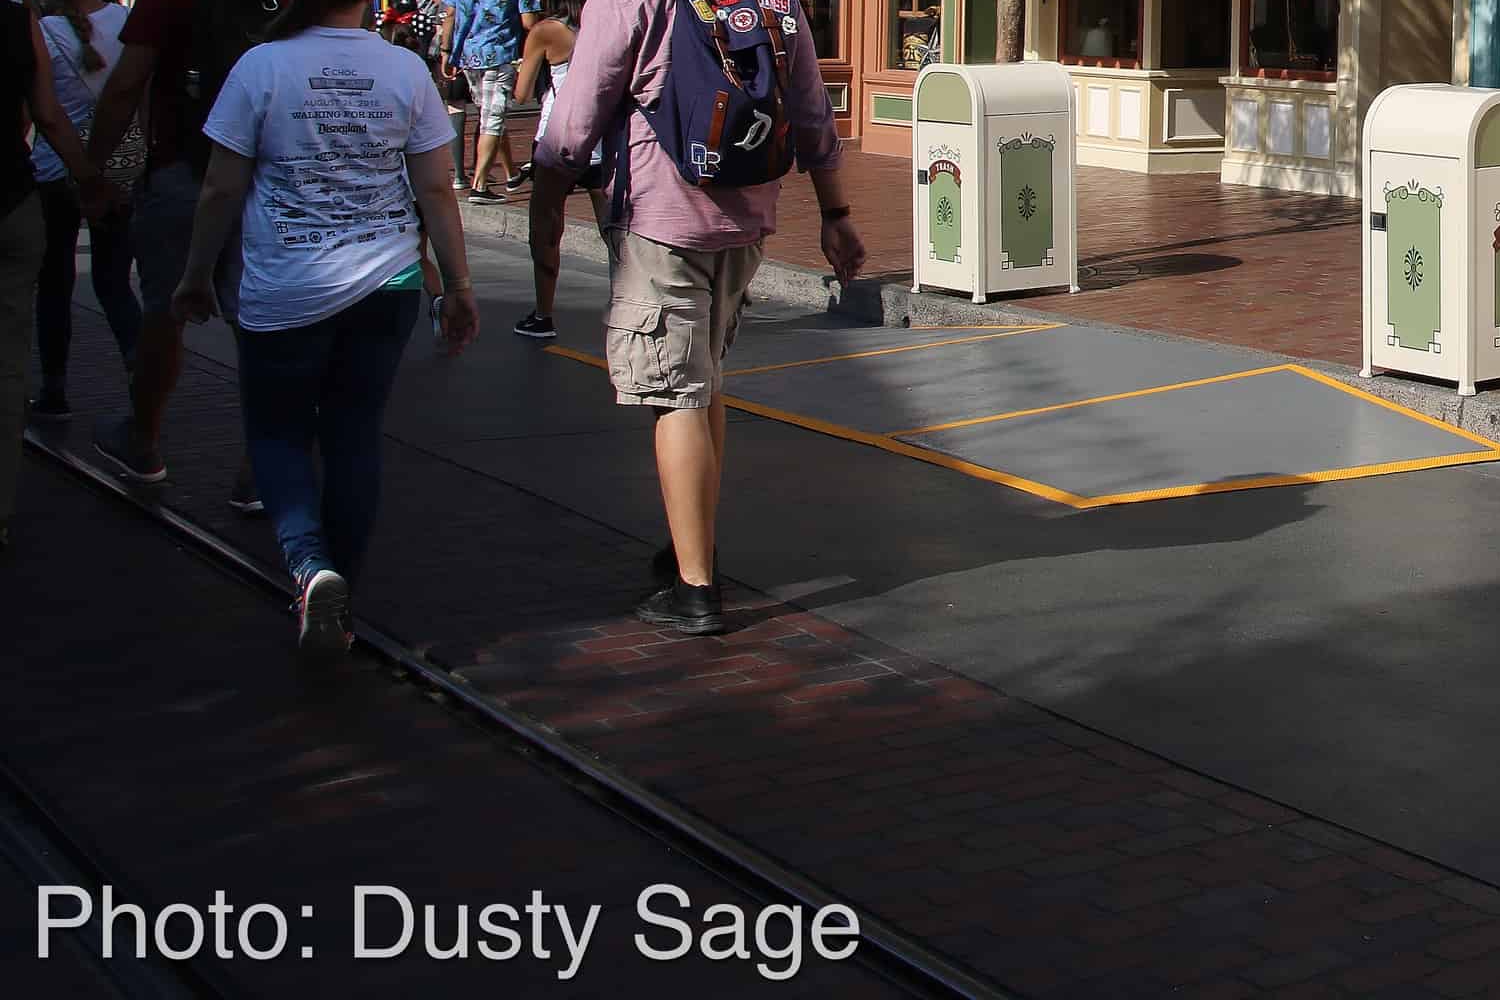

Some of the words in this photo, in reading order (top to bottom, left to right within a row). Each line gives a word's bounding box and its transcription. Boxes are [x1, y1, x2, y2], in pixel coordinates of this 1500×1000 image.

[291, 111, 340, 119] WALKING
[343, 111, 365, 119] FOR
[368, 111, 393, 119] KIDS
